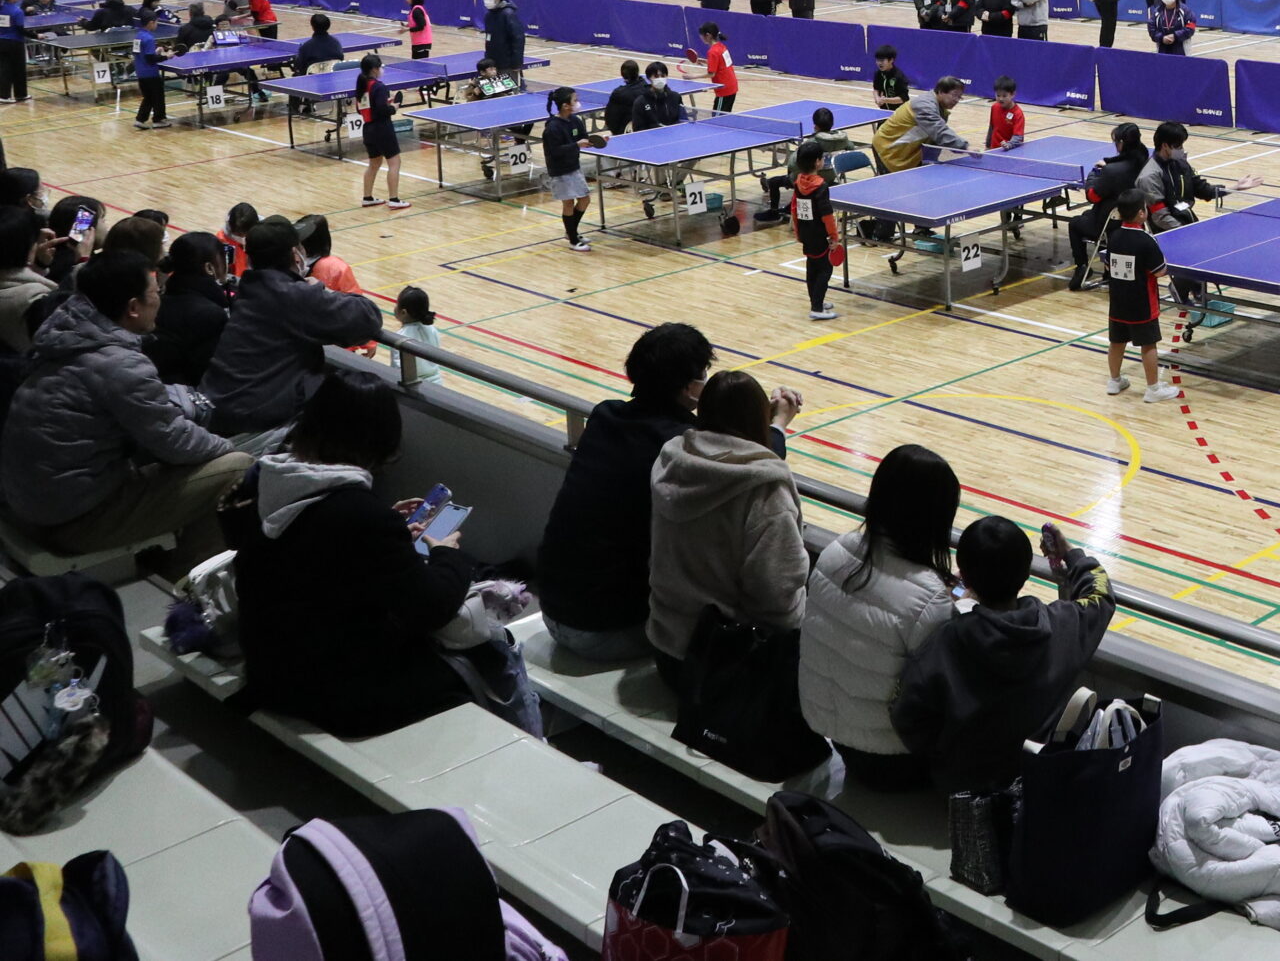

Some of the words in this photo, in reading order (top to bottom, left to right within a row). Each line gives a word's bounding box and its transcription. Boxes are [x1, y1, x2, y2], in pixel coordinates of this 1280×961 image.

[96, 70, 107, 79] 17
[485, 84, 493, 92] 5
[505, 79, 513, 87] 5
[210, 94, 222, 105] 18
[350, 119, 362, 131] 19
[510, 151, 527, 166] 20
[689, 191, 703, 206] 21
[946, 215, 966, 225] KAWAI
[962, 243, 980, 262] 22
